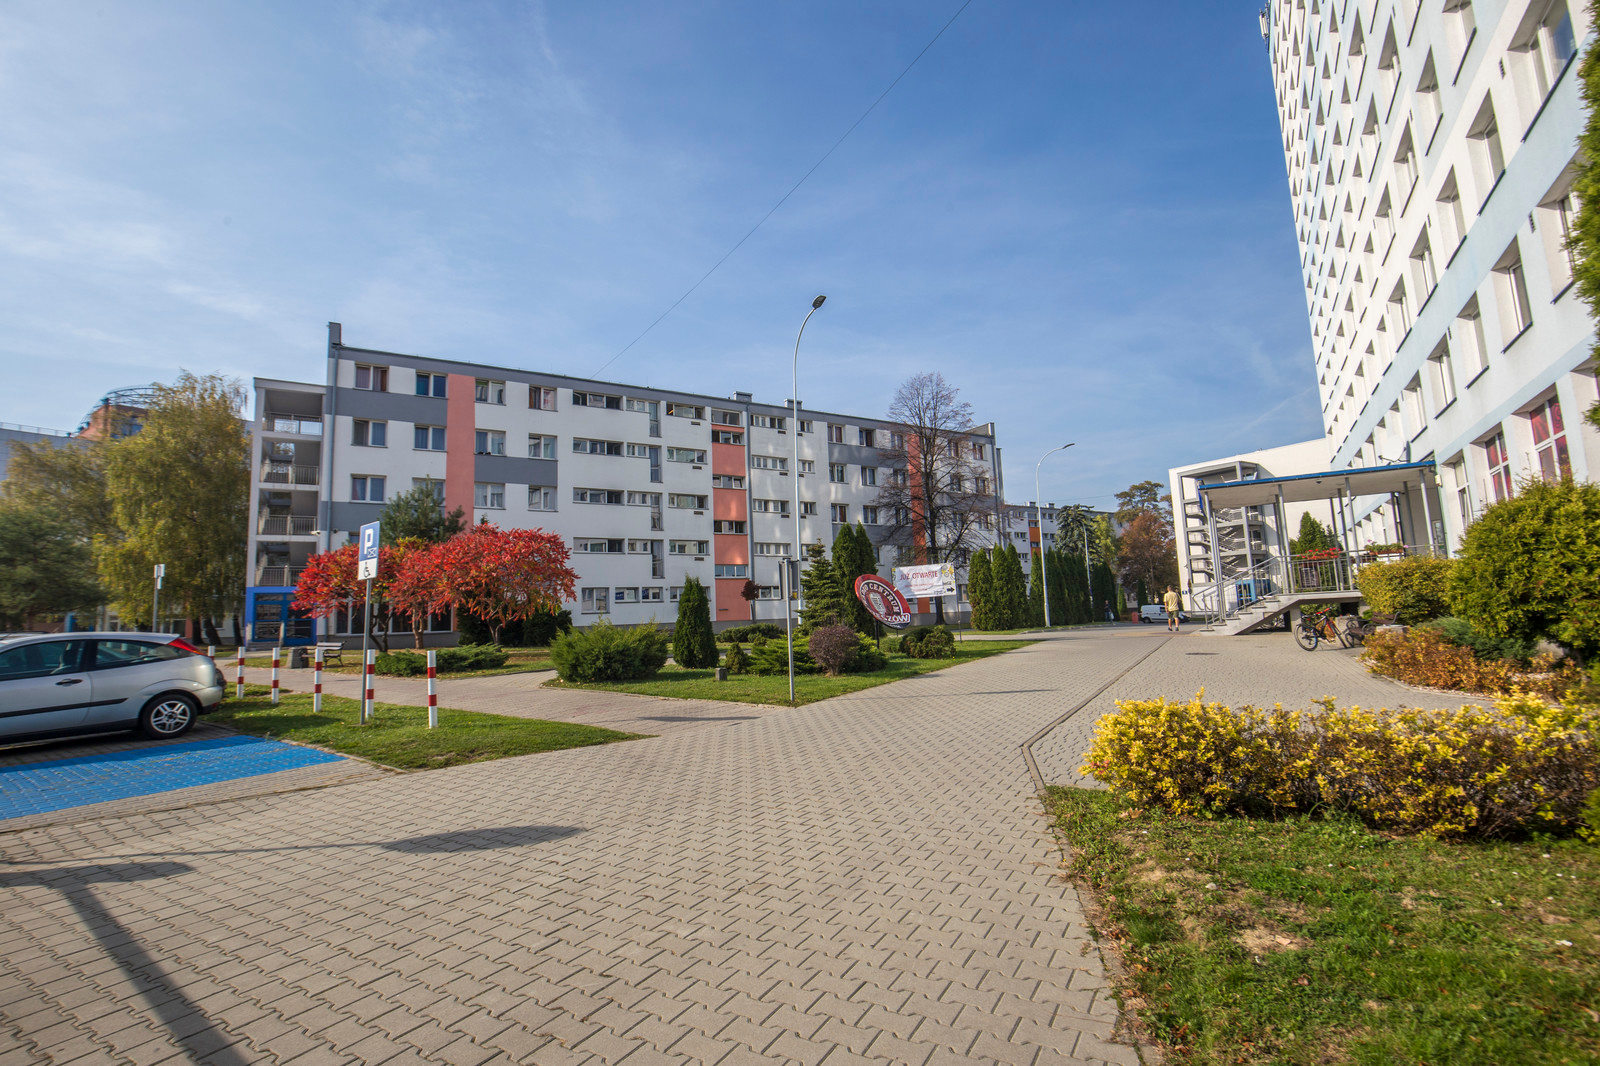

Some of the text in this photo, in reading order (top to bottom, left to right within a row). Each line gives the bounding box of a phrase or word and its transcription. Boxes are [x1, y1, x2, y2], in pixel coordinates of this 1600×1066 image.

[364, 528, 374, 555] P
[912, 570, 938, 580] OTWARTE
[869, 583, 901, 613] CENTRUM
